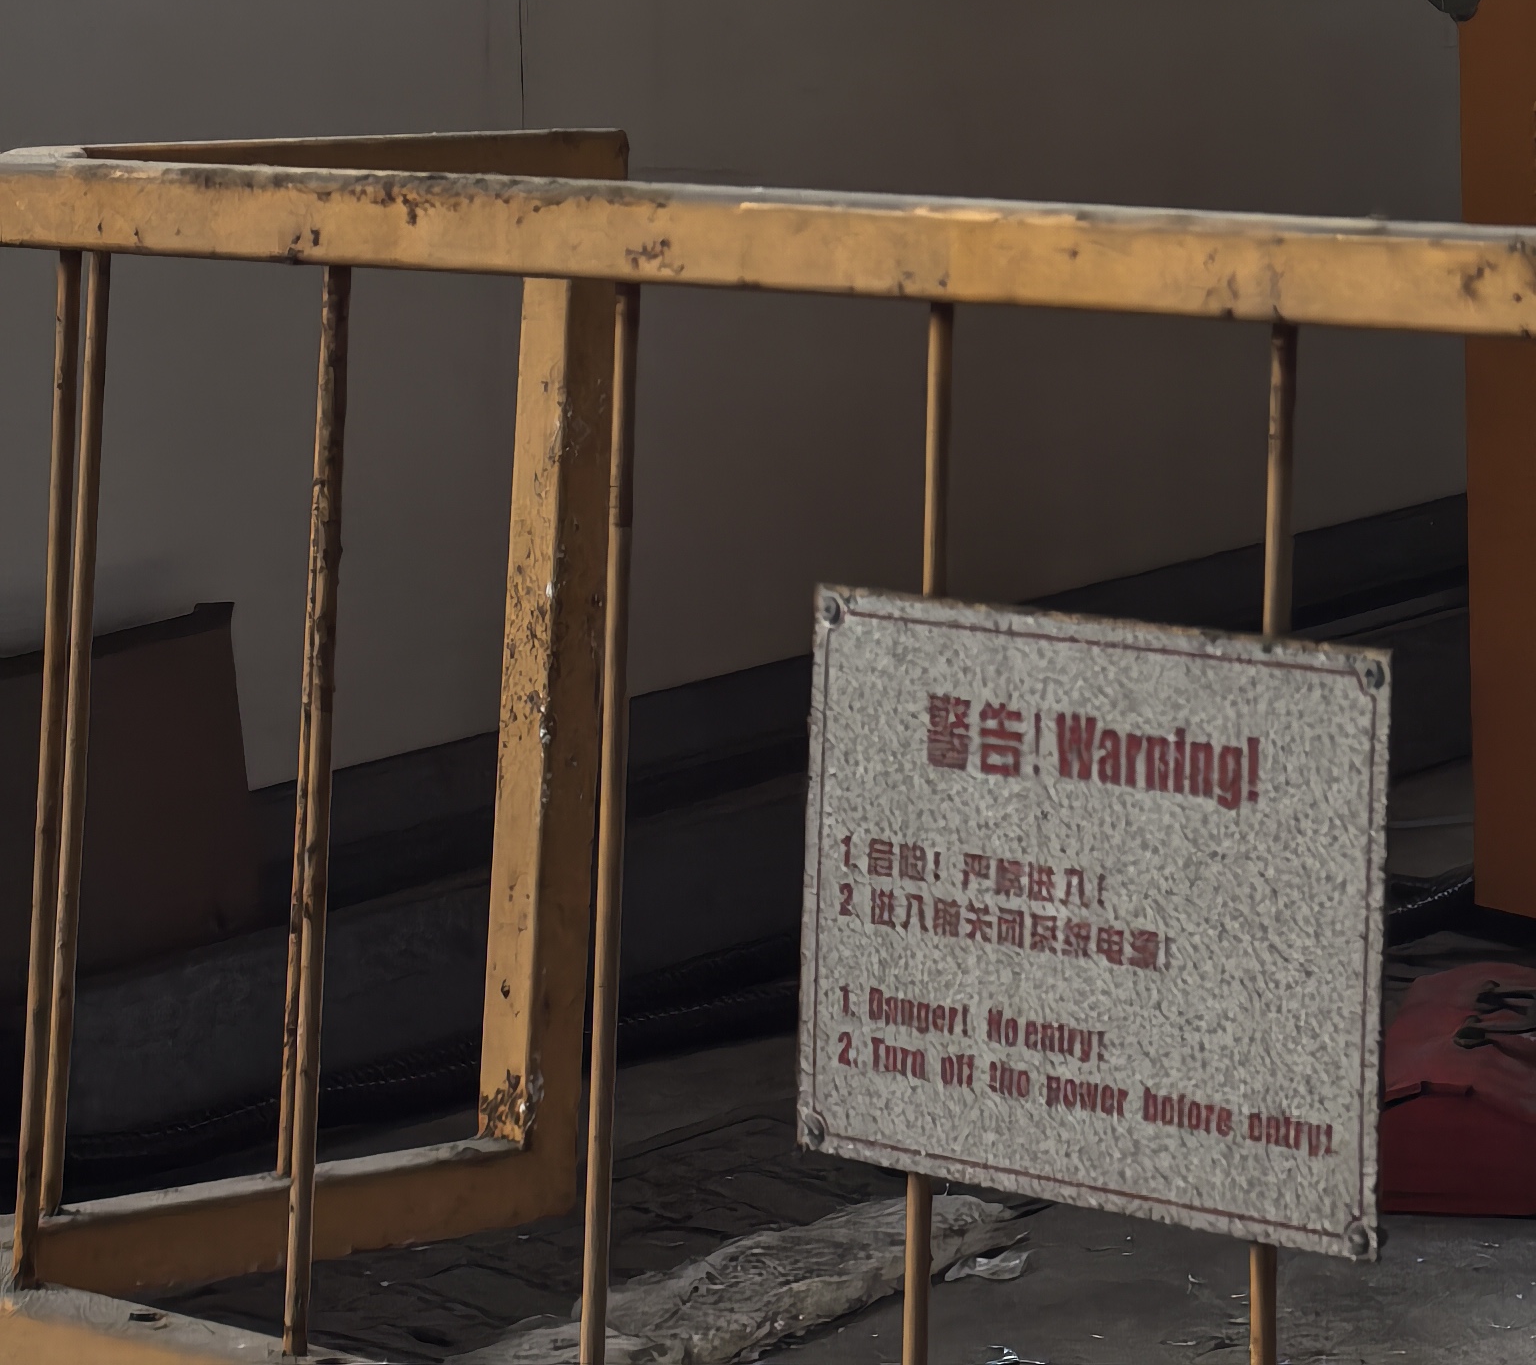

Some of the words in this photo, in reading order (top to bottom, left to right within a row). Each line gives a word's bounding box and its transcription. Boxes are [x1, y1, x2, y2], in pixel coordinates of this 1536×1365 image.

[1055, 710, 1261, 811] Warning!
[868, 986, 969, 1037] Danger!
[986, 1007, 1019, 1048] No
[1024, 1019, 1107, 1064] entry!
[870, 1036, 930, 1082] Turn
[1045, 1073, 1130, 1119] power
